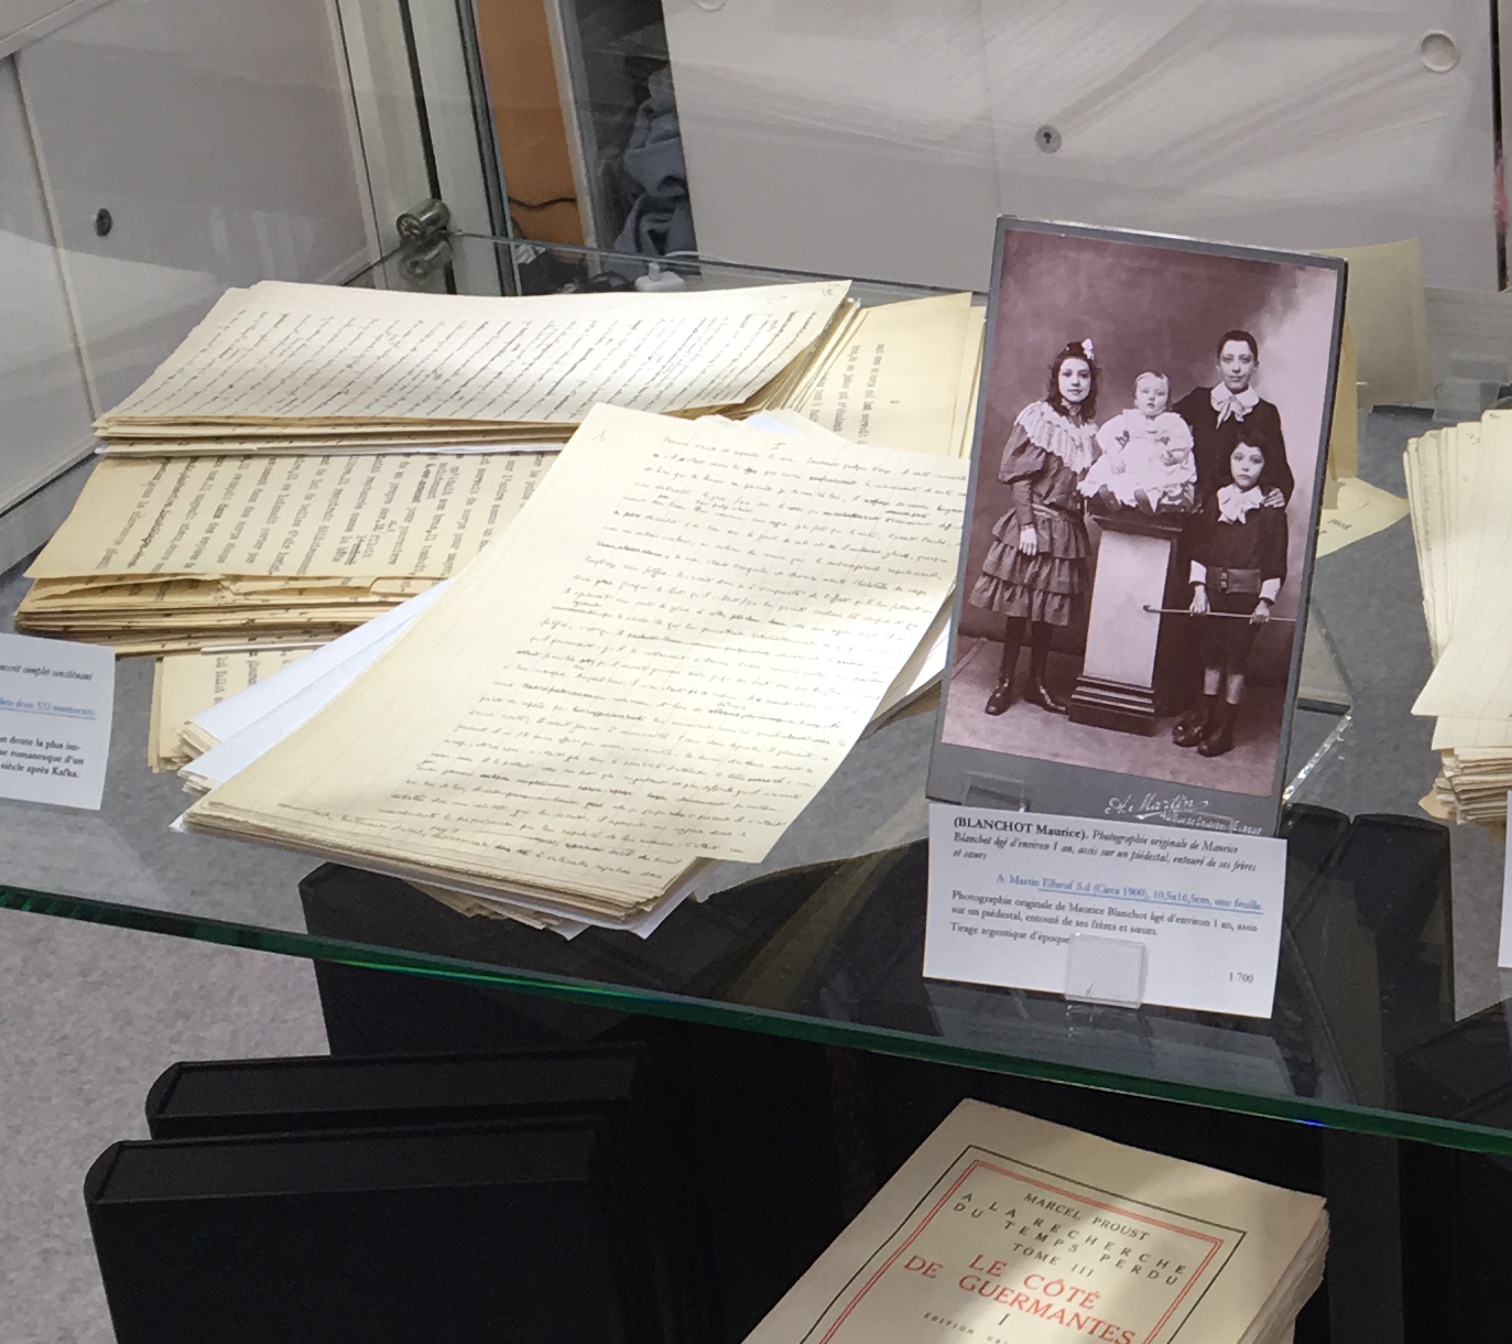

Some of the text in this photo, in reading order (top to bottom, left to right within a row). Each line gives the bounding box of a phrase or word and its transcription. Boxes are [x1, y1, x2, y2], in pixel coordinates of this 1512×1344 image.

[45, 739, 63, 751] plus
[953, 816, 1034, 834] (BLANCHOT
[1035, 823, 1089, 842] Maurice).
[1189, 839, 1200, 850] de
[962, 1192, 1187, 1276] A LA RECHERCHE
[1022, 1192, 1150, 1242] MARCEL PROUST
[953, 1202, 1179, 1287] DU TEMPS PERDU
[1013, 1242, 1095, 1278] TOME III
[902, 1254, 943, 1280] DE
[968, 1254, 1101, 1311] LE CÔTÉ
